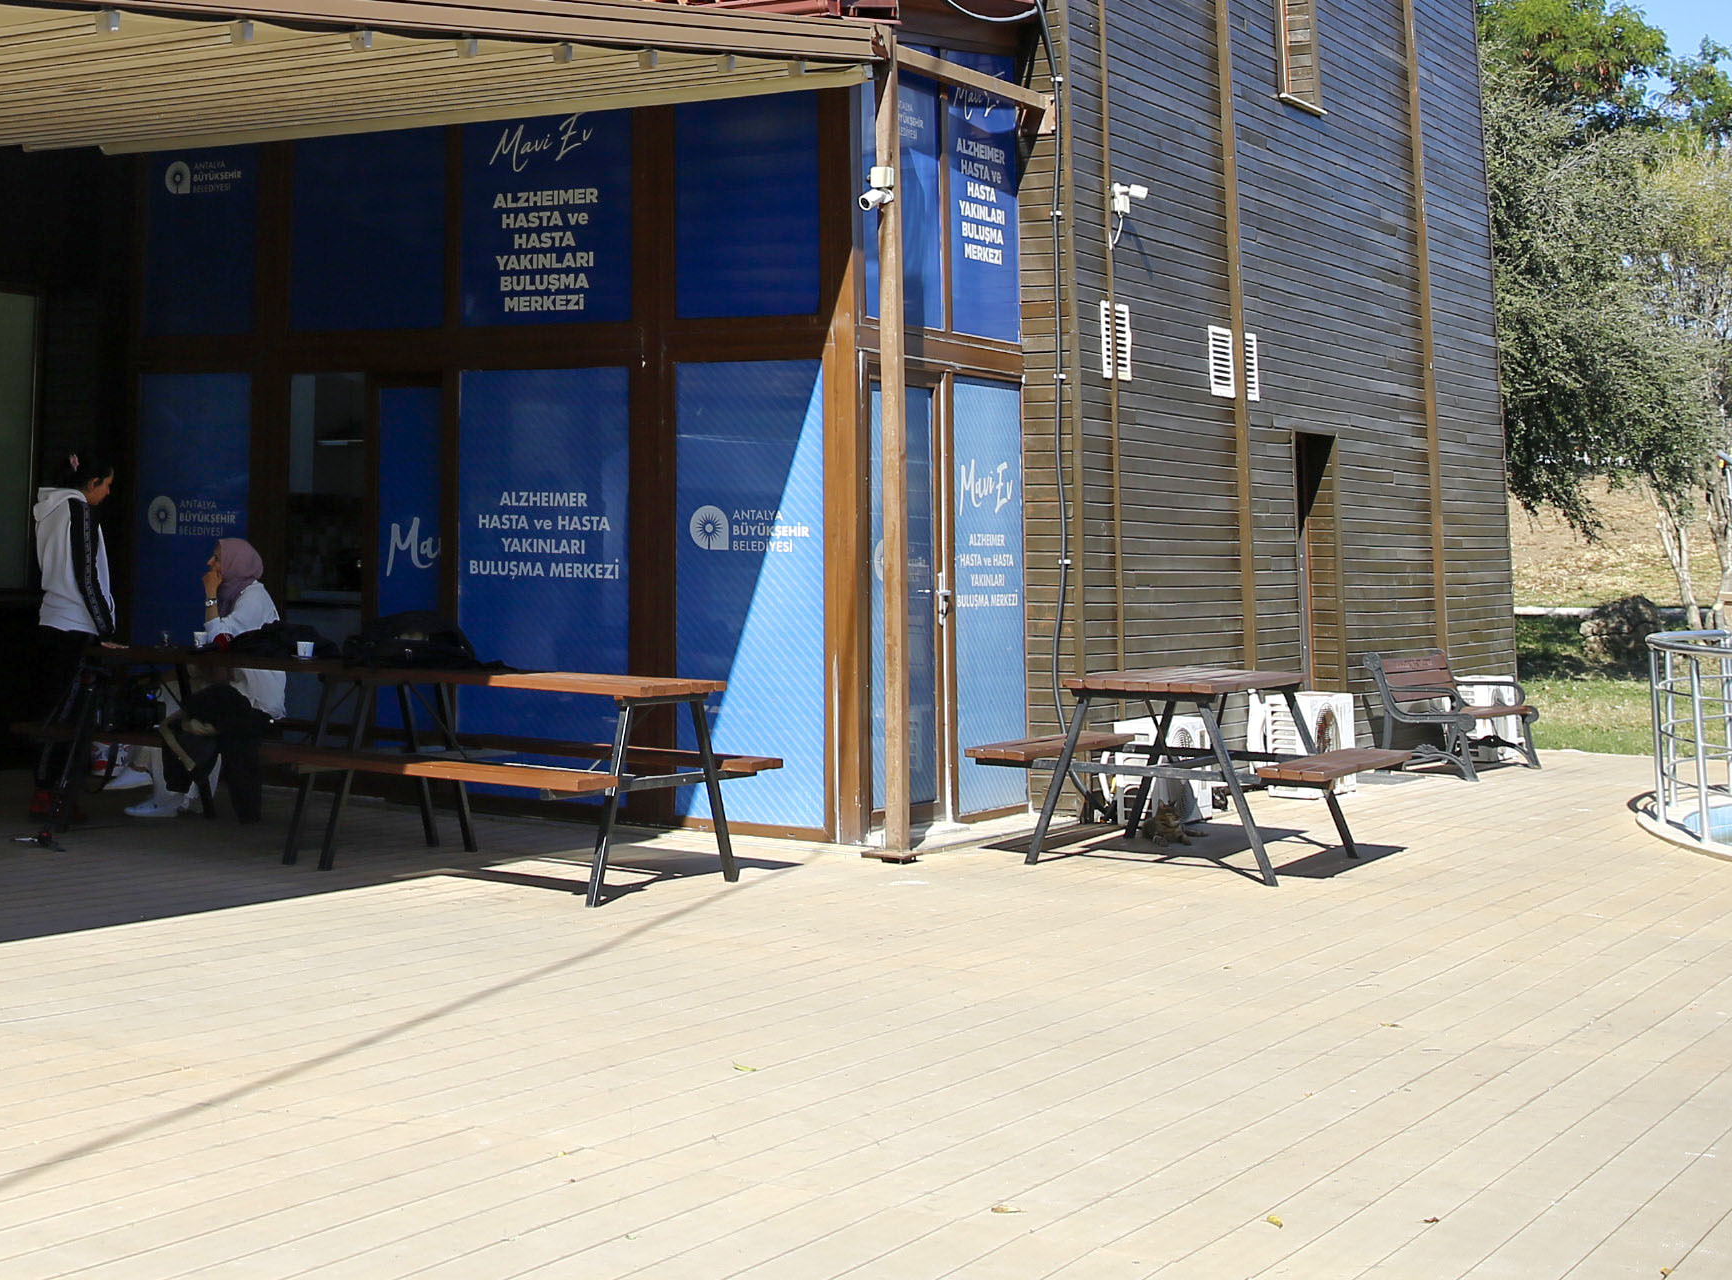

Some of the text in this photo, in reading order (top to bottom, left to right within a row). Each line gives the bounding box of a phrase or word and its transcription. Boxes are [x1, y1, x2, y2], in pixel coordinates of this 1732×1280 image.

[489, 112, 593, 172] Mavi Ev
[956, 137, 1005, 165] ALZHEIMER
[960, 159, 1002, 184] HASTA ve
[493, 188, 598, 208] ALZHEIMER
[967, 181, 997, 203] HASTA
[502, 211, 589, 229] HASTA ve
[959, 200, 1006, 226] YAKINLARI
[514, 231, 576, 249] HASTA
[961, 221, 1004, 246] BULUŞMA
[495, 251, 594, 271] YAKINLARI
[500, 273, 589, 292] BULUŞMA
[959, 459, 1013, 516] Mavi Ev
[179, 499, 217, 509] ANTALYA
[499, 491, 588, 507] ALZHEIMER
[179, 511, 236, 525] BÜYÜKŞEHİR
[478, 514, 611, 531] HASTA ve HASTA
[733, 509, 784, 521] ANTALYA
[733, 522, 810, 539] BÜYÜKŞEHİR
[501, 538, 586, 554] YAKINLARI
[733, 539, 793, 552] BELEDİYESİ
[969, 533, 1005, 547] ALZHEIMER
[469, 558, 619, 580] BULUŞMA MERKEZİ
[959, 553, 1014, 567] HASTA ve HASTA
[970, 573, 1005, 587] YAKINLARI
[956, 589, 1018, 610] BULUŞMA MERKEZİ
